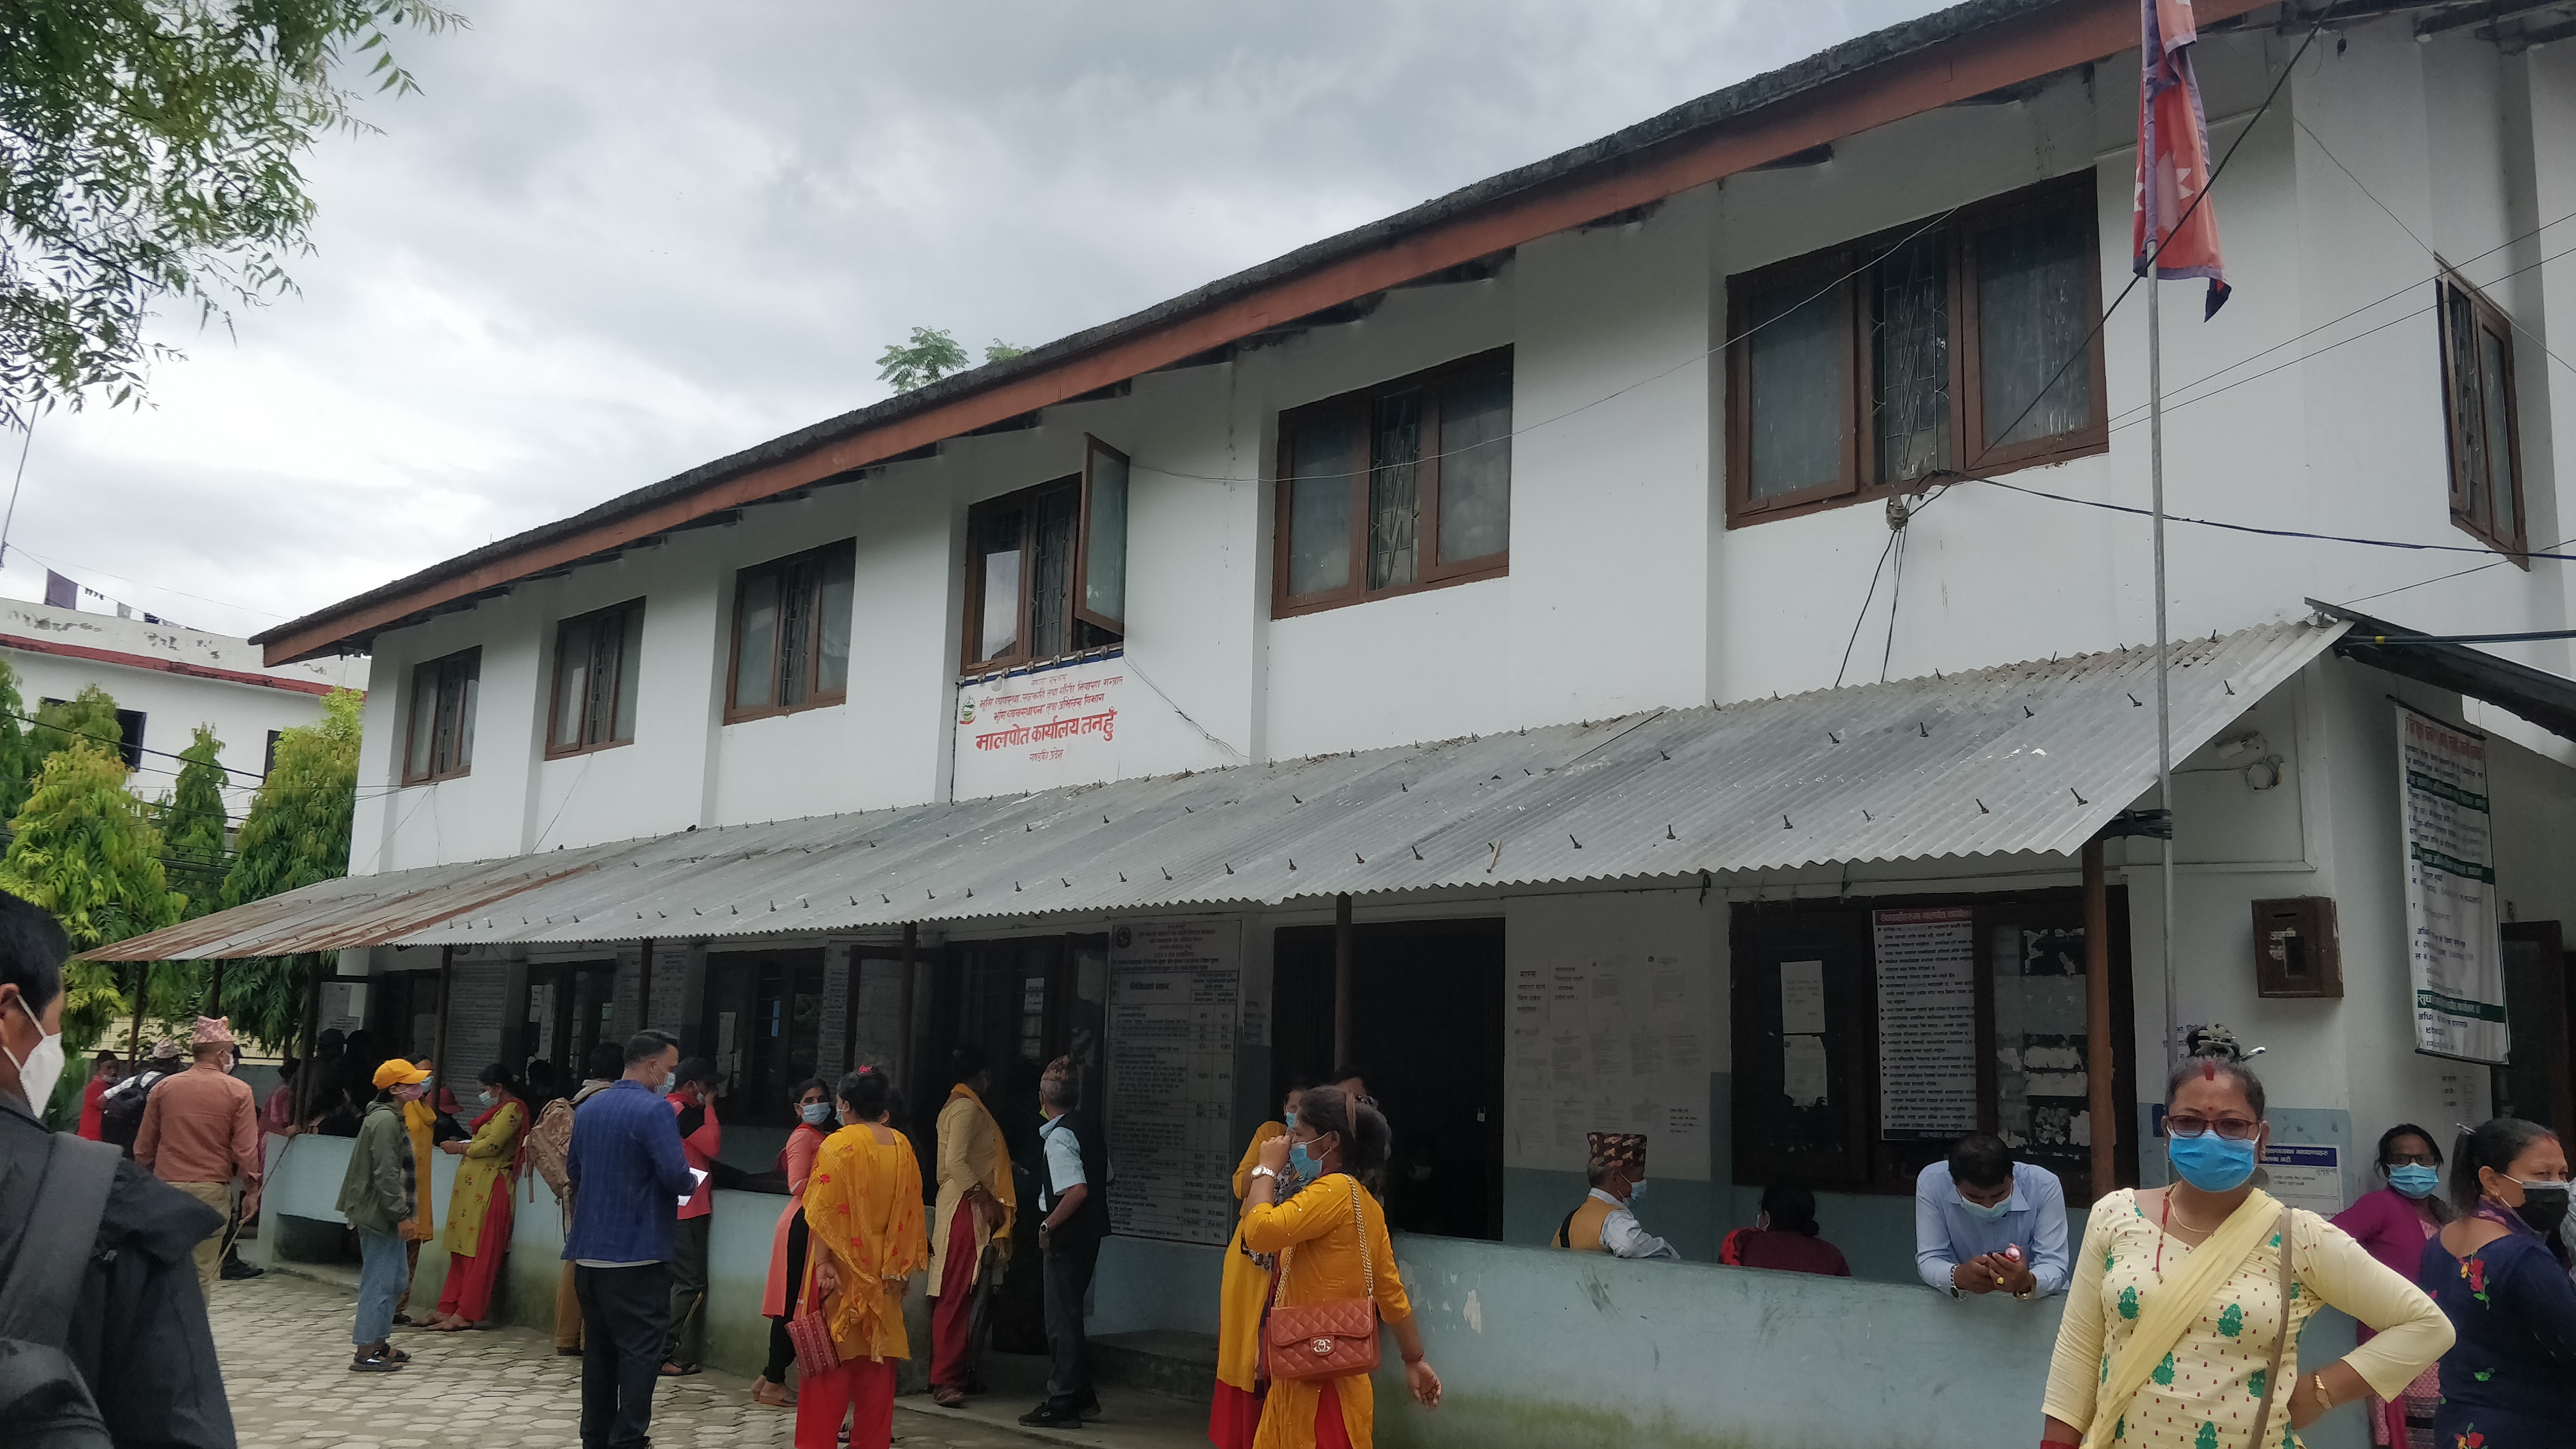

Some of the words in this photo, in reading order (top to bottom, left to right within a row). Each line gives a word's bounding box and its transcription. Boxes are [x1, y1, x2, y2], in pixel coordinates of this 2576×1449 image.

[975, 723, 1031, 751] मालपोत
[1031, 715, 1079, 742] कार्यालय
[1081, 705, 1118, 742] तनहुँ
